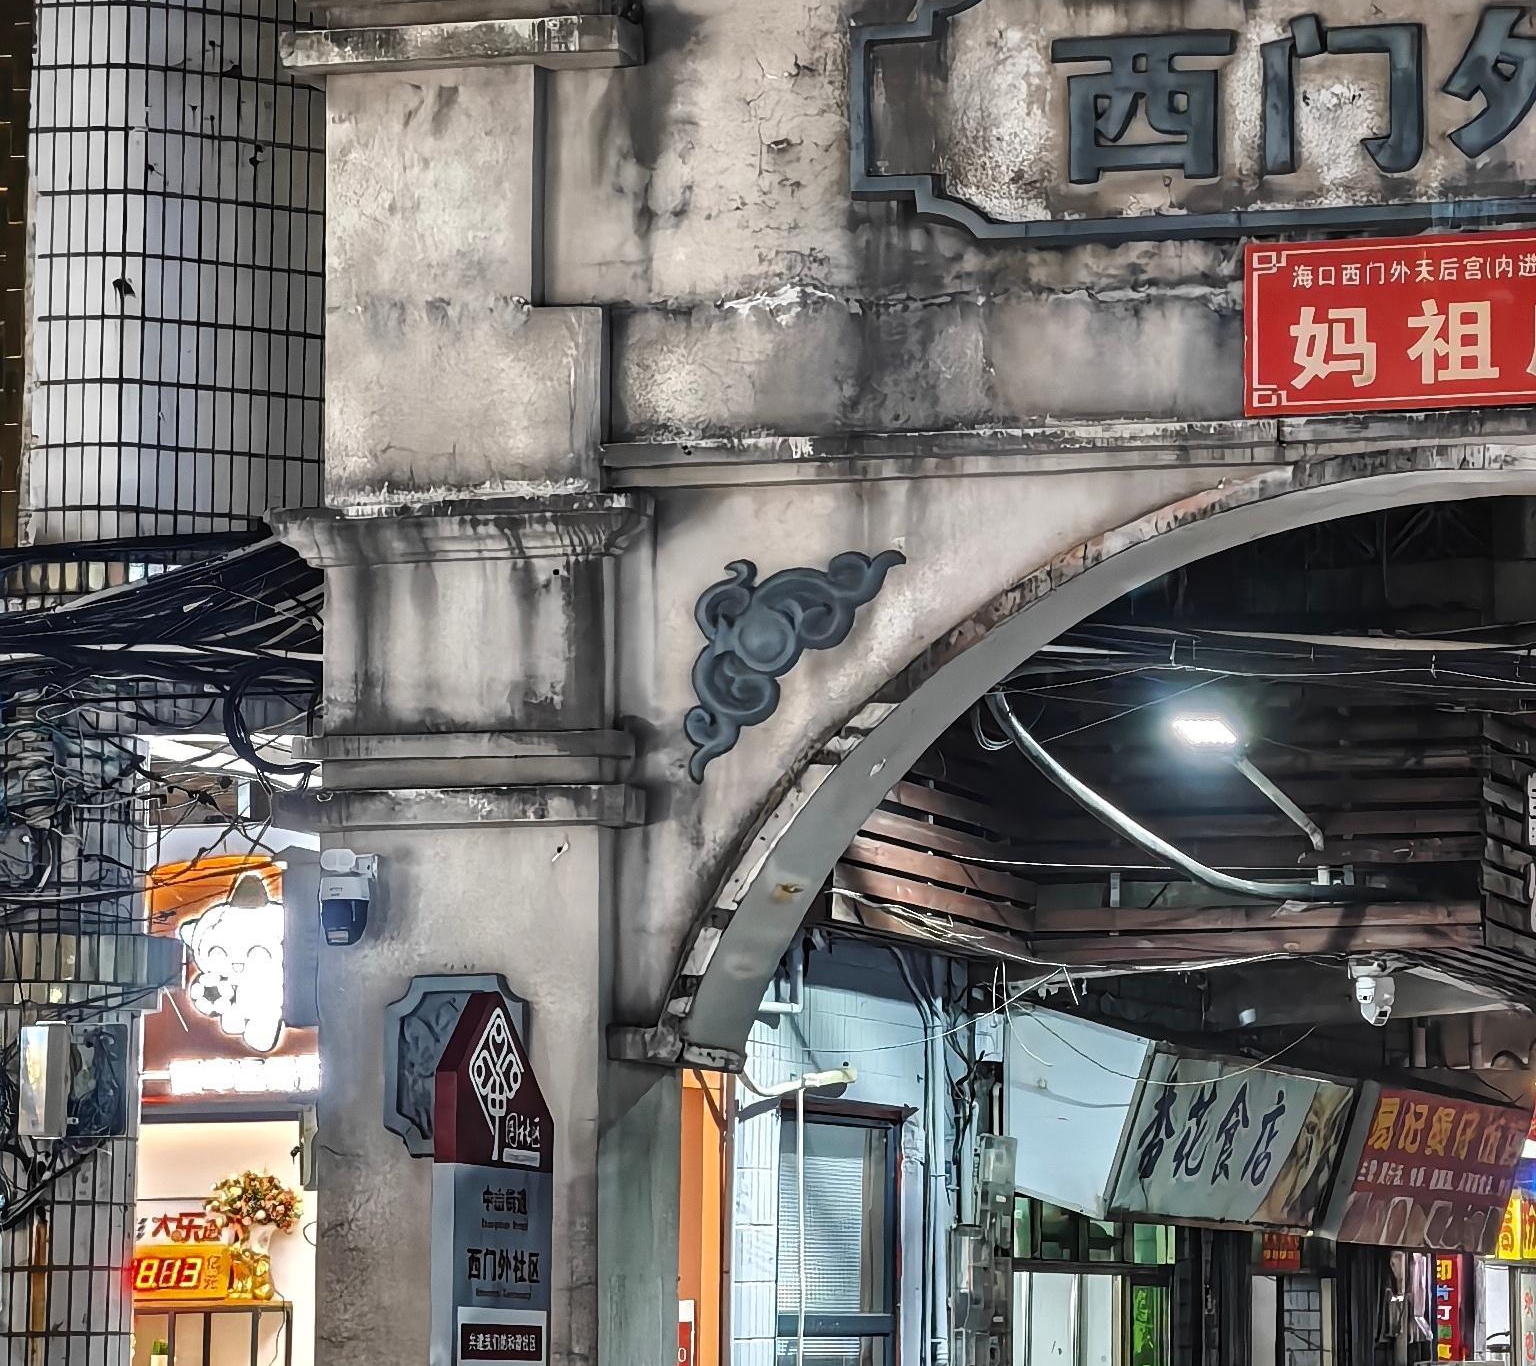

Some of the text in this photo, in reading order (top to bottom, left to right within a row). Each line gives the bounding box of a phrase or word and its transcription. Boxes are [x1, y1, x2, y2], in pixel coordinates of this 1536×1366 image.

[466, 1247, 541, 1284] 西门外社区
